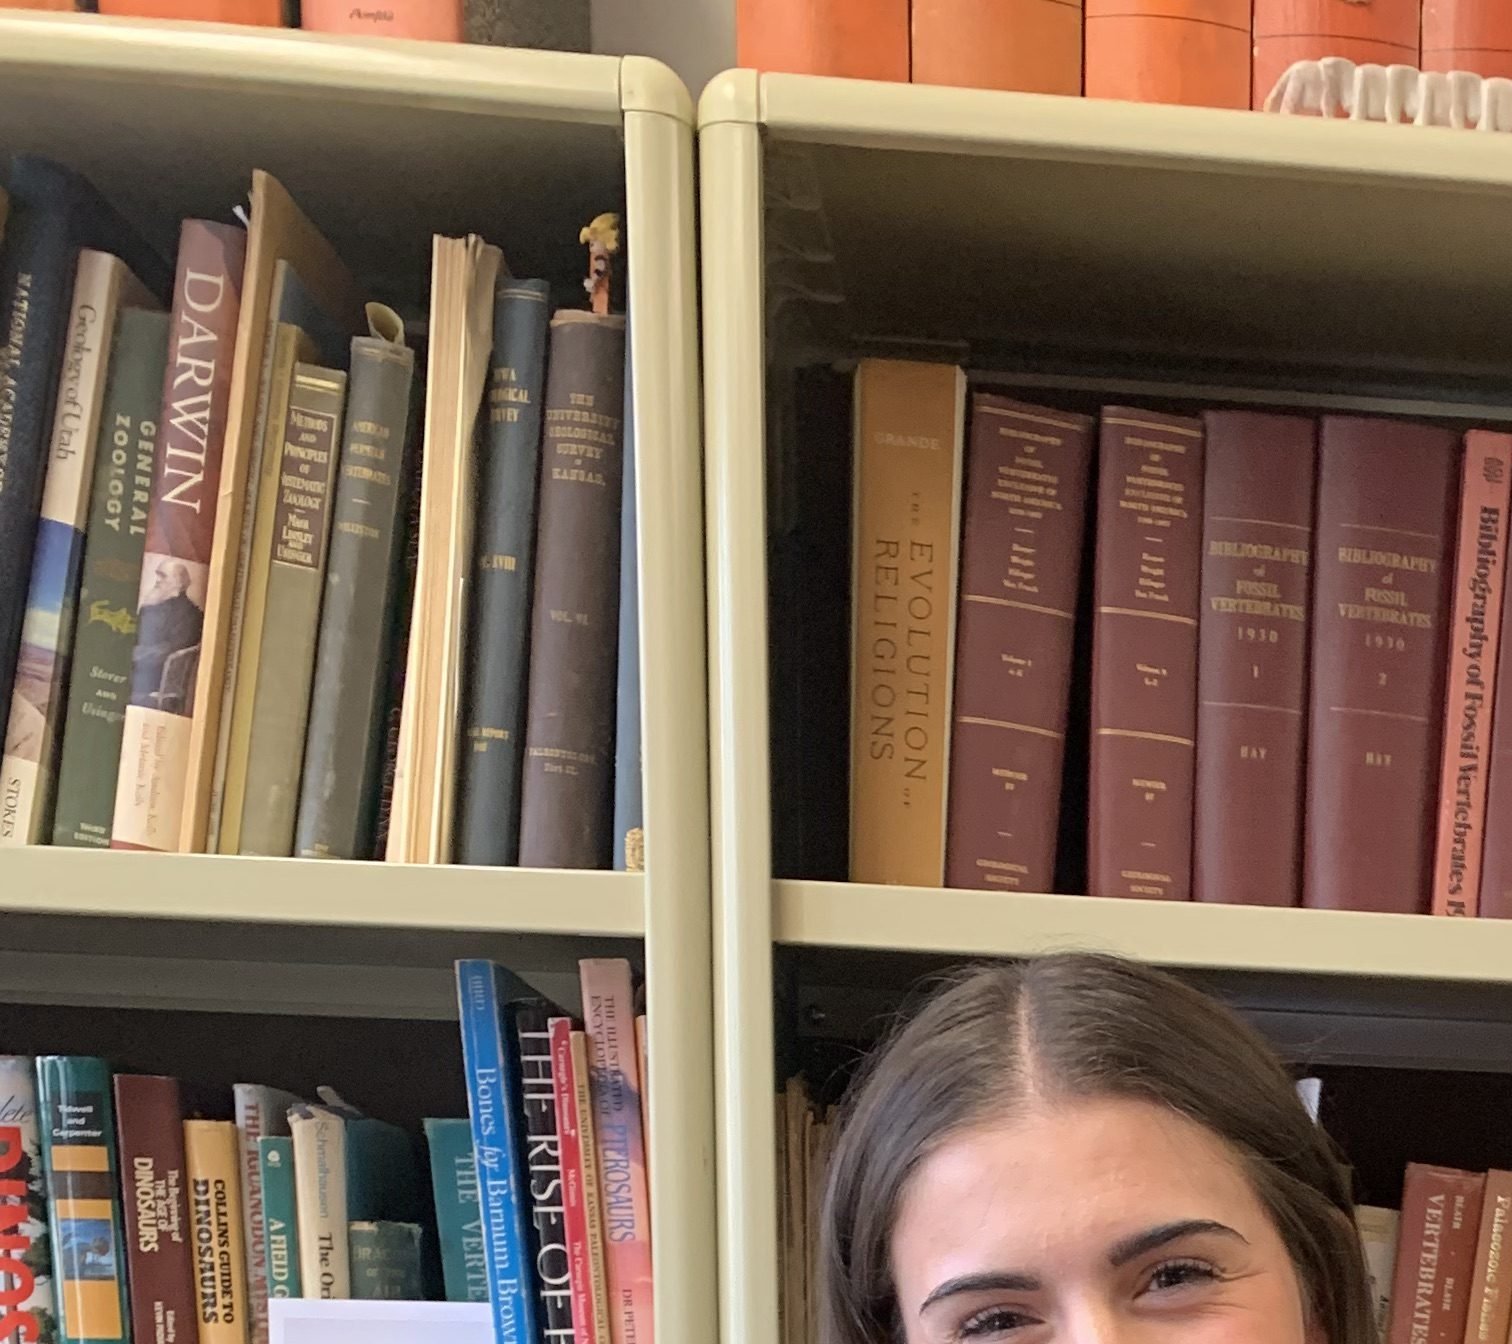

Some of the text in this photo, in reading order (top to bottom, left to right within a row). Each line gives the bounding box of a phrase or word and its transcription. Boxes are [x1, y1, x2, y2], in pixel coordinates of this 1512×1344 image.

[161, 268, 225, 515] DARWIN
[104, 413, 131, 531] ZOOLOGY
[129, 420, 157, 535] GENERAL
[1208, 540, 1310, 566] BIBLIOGRAPHY
[1337, 545, 1436, 575] BIBLIOGRAPHY
[1462, 505, 1500, 665] Bibliography
[870, 539, 899, 761] RELIGIONS
[904, 540, 933, 781] EVOLUTION
[1338, 602, 1433, 629] VERTEBRATES
[1460, 691, 1485, 759] Fossil
[1448, 760, 1480, 896] Vertebrates
[517, 1031, 557, 1119] THE
[604, 995, 624, 1112] THE ILLUSTRATED
[52, 1128, 103, 1140] Carpenter
[57, 1104, 94, 1114] Tidwell
[66, 1117, 87, 1126] and
[133, 1157, 159, 1253] DINOSAURS
[475, 1067, 497, 1136] Bones
[486, 1178, 512, 1269] Barnum
[526, 1133, 566, 1232] RISE
[604, 1125, 637, 1243] PTEROSAURS
[193, 1178, 219, 1324] DINOSAURS
[213, 1179, 235, 1325] COLLINS GUIDE TO
[318, 1234, 335, 1267] The
[536, 1242, 574, 1310] OF
